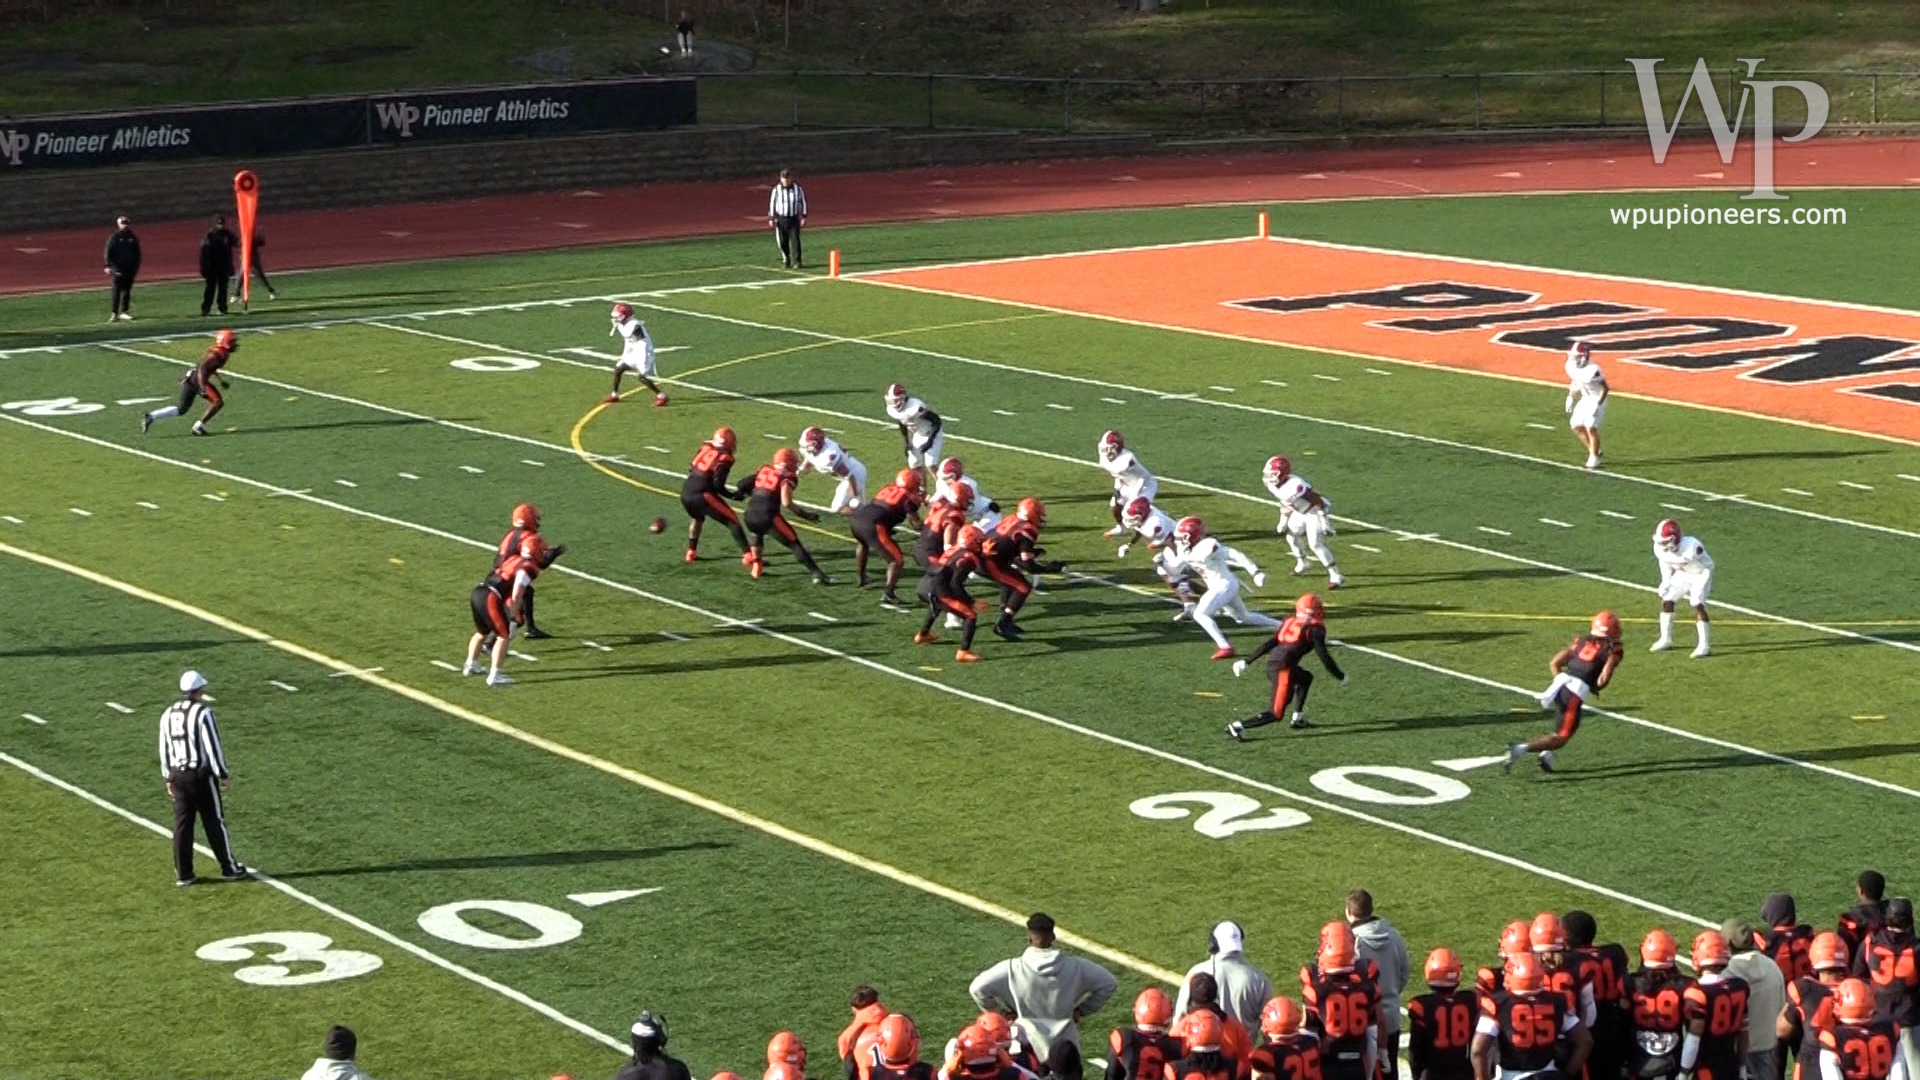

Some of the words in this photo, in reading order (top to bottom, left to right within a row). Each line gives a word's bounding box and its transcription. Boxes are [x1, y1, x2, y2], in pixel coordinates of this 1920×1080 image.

[423, 104, 493, 127] Pioneer
[495, 97, 570, 122] Athletics
[34, 132, 110, 155] Pioneer
[112, 124, 192, 151] Athletics
[1435, 1004, 1470, 1049] 18
[1511, 1003, 1556, 1048] 95
[1633, 989, 1680, 1031] 29
[1711, 990, 1746, 1035] 87
[1843, 1035, 1892, 1079] 38
